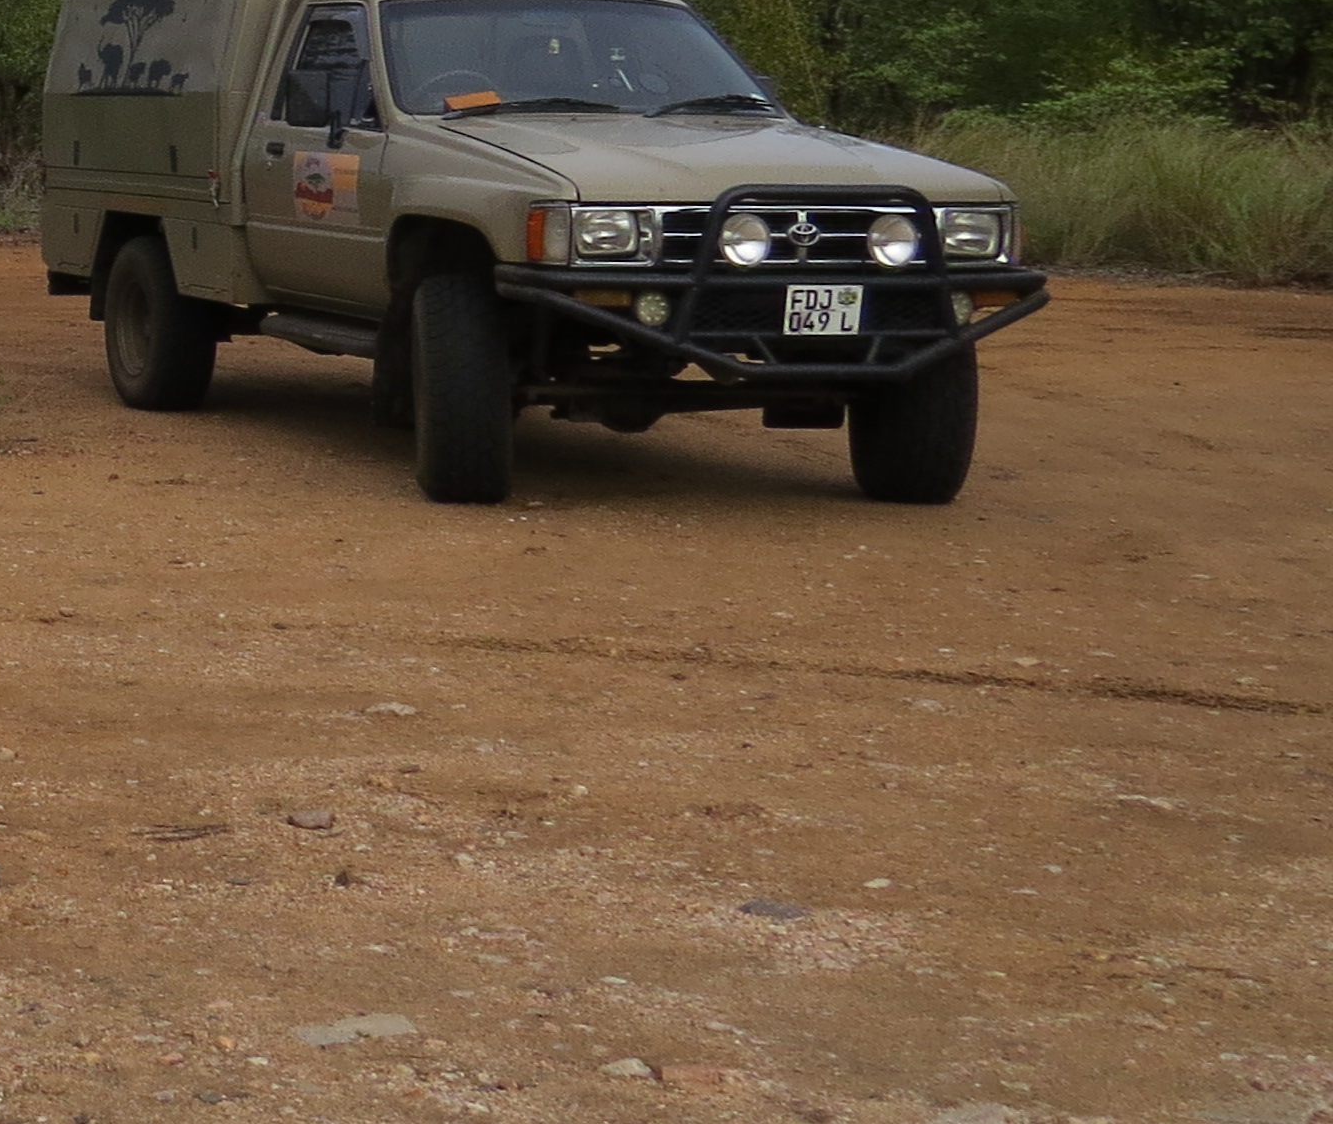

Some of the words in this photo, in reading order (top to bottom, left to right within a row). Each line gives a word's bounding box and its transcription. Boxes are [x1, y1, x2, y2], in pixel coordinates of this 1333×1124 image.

[791, 289, 833, 310] FDJ
[789, 312, 830, 332] 049
[841, 312, 853, 331] L
